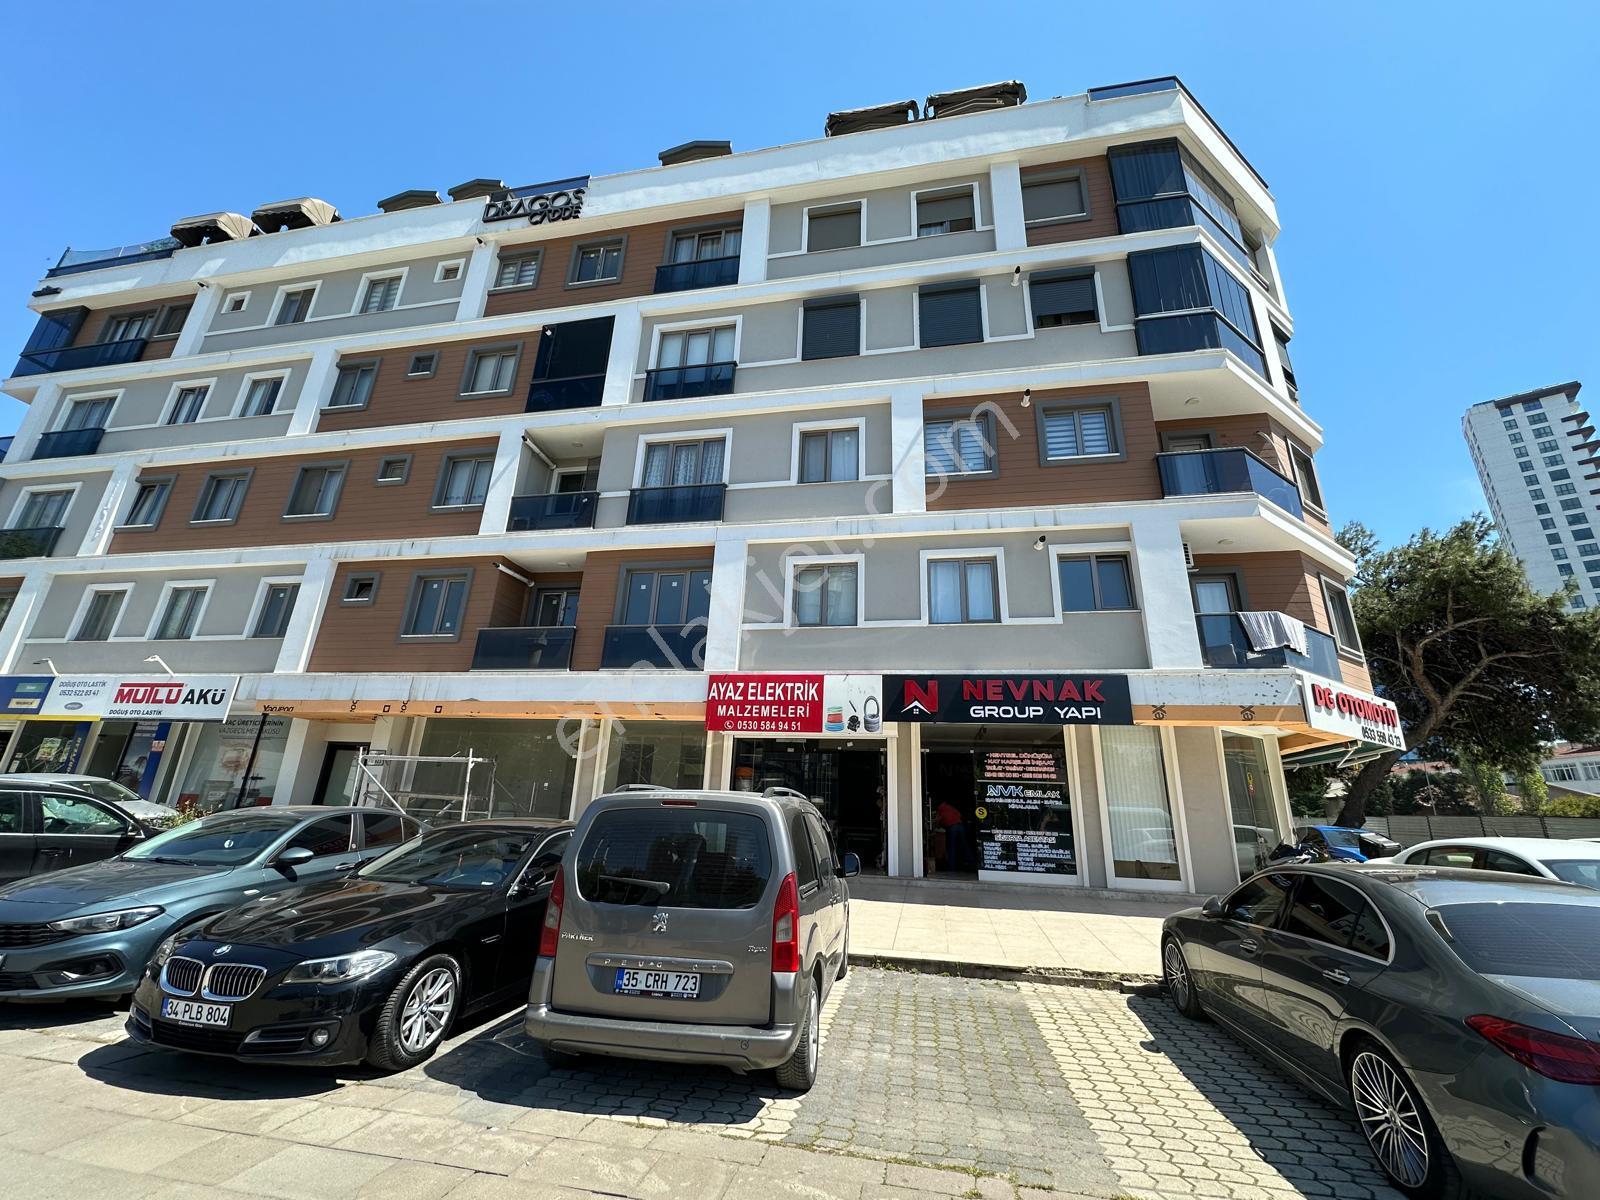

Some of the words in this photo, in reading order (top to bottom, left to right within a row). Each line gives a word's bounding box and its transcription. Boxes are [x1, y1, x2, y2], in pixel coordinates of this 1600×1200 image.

[482, 188, 586, 223] DRAGOS
[528, 206, 582, 225] CADDE
[113, 683, 184, 705] MUTLU
[181, 689, 227, 705] AKÜ
[708, 682, 745, 700] AYAZ
[747, 679, 819, 701] ELEKTRİK
[962, 679, 1105, 702] NEVNAK
[717, 703, 810, 718] MALZEMELERİ
[969, 705, 1044, 719] GROUP
[1054, 706, 1102, 720] YAPI
[1336, 691, 1398, 728] OTOMOTİV
[737, 720, 758, 730] 0530
[760, 721, 776, 730] 584
[778, 721, 789, 730] 94
[791, 722, 801, 731] 51
[986, 784, 1024, 797] NVK
[1024, 789, 1061, 799] EMLAK
[623, 971, 639, 987] 35
[645, 973, 669, 990] CRH
[674, 975, 698, 991] 723
[167, 1001, 180, 1017] 34
[182, 1003, 204, 1021] PLB
[206, 1006, 228, 1024] 804
